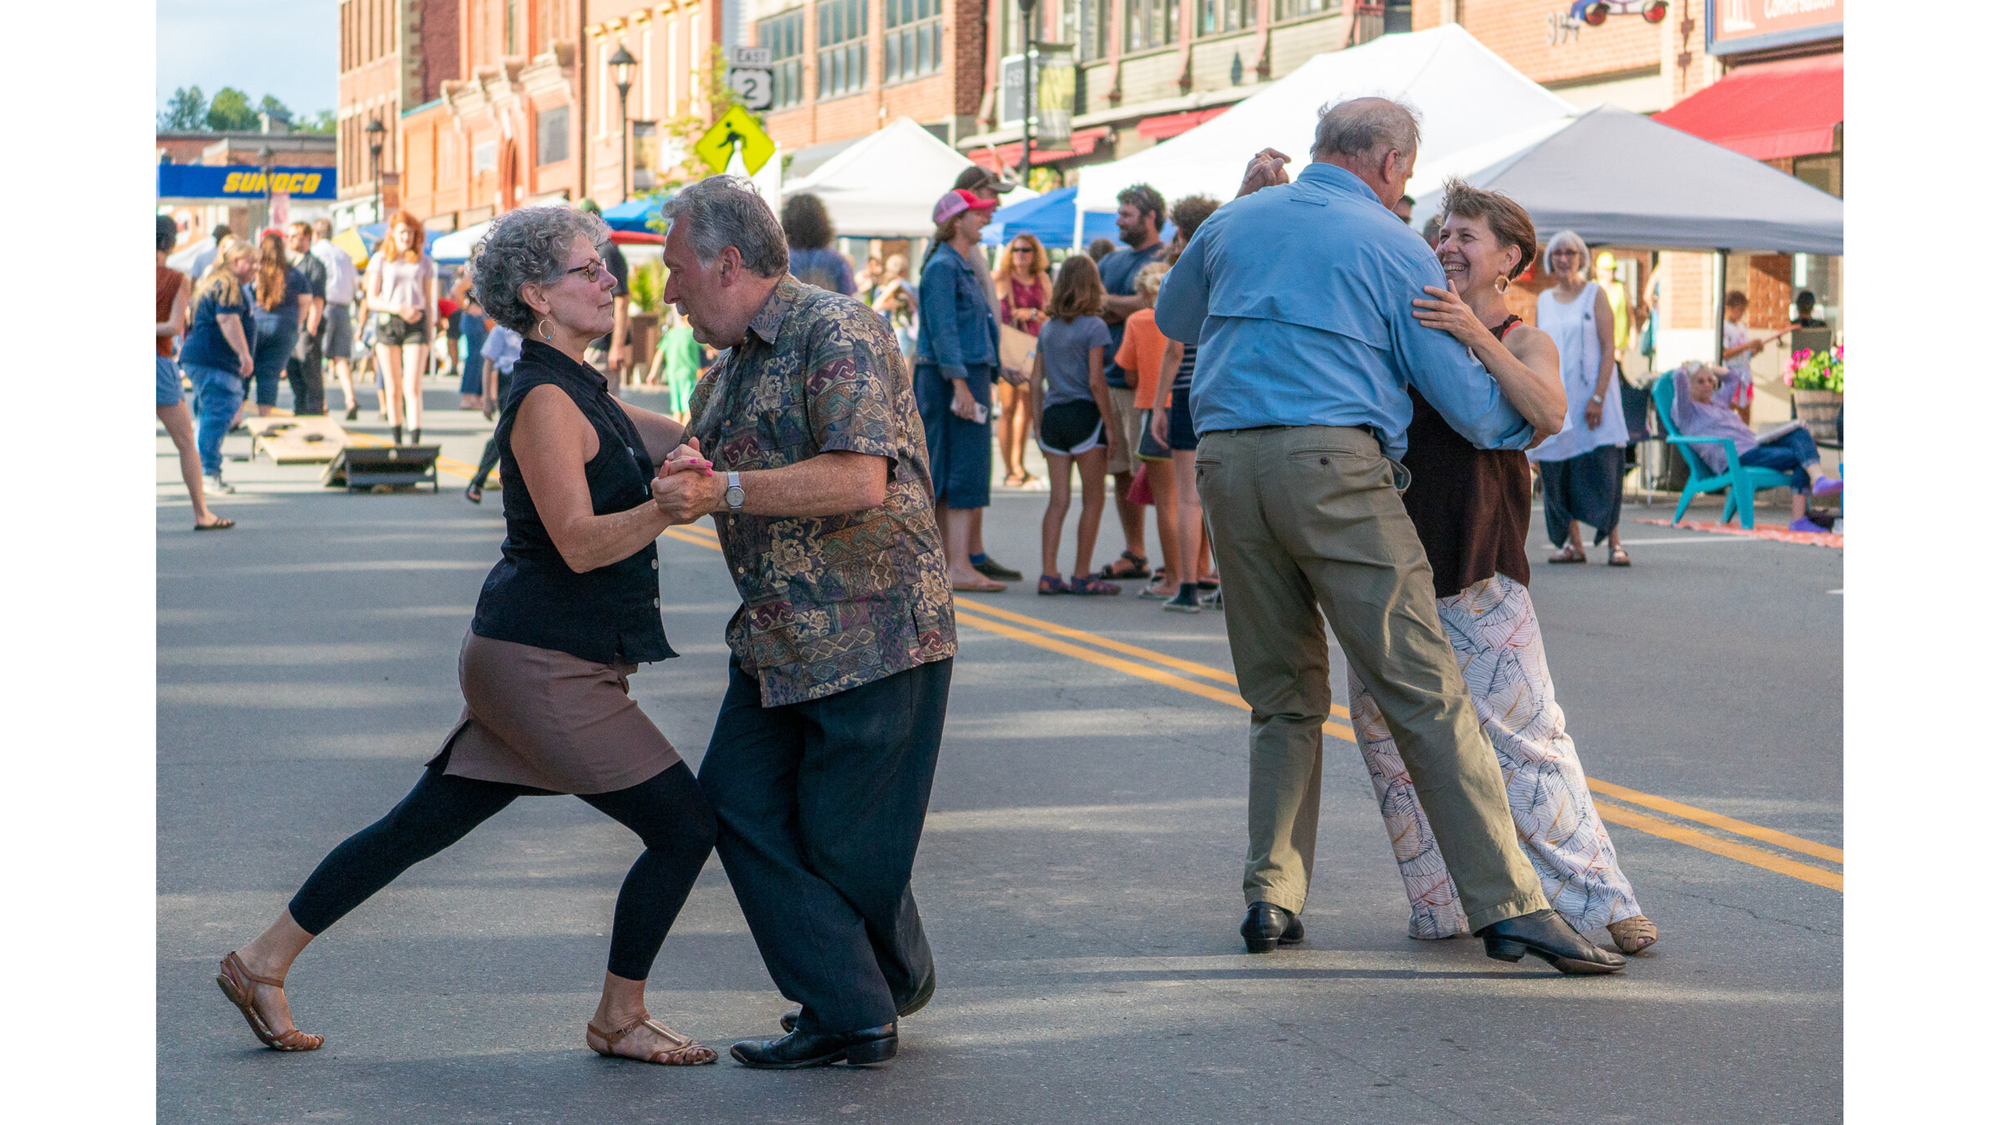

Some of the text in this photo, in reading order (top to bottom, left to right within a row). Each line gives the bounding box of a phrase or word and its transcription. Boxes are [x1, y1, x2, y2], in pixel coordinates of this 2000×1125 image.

[736, 48, 767, 63] EAST
[743, 78, 758, 100] 2
[222, 171, 322, 194] SUNOCO
